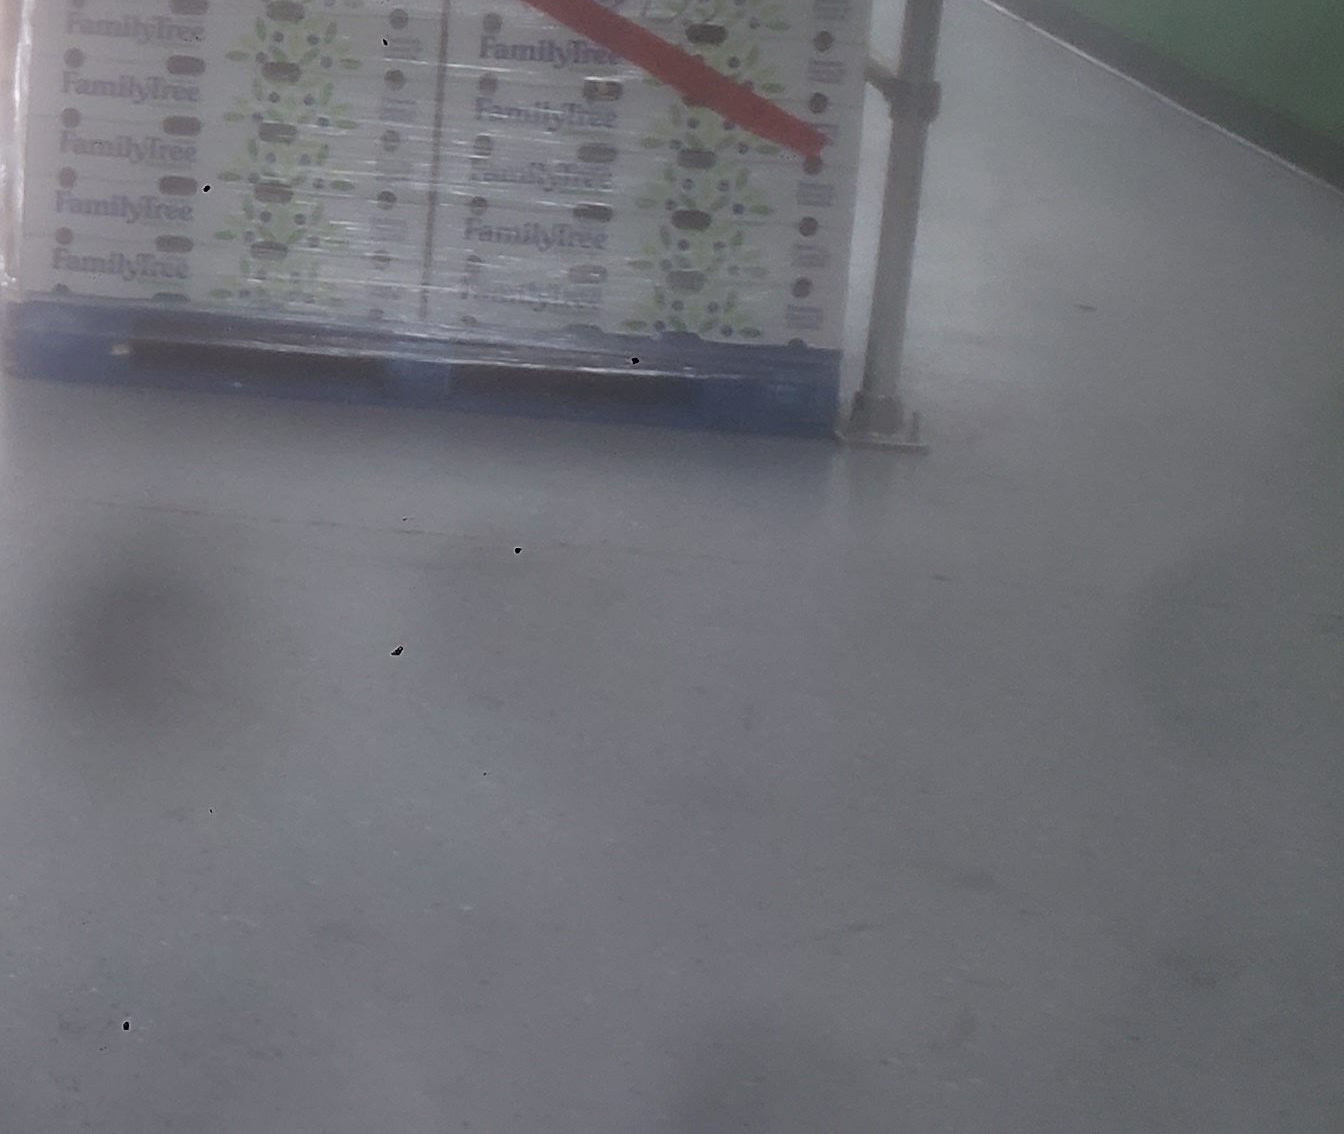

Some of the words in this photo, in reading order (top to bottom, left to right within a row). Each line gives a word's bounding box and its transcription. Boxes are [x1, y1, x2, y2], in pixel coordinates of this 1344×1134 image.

[66, 13, 205, 45] FamilyTree
[61, 73, 200, 106] FamilyTree
[475, 97, 617, 131] FamilyTree
[59, 131, 198, 164] FamilyTree
[54, 192, 194, 225] FamilyTree
[465, 217, 608, 250] FamilyTree
[52, 248, 189, 281] FamilyTree
